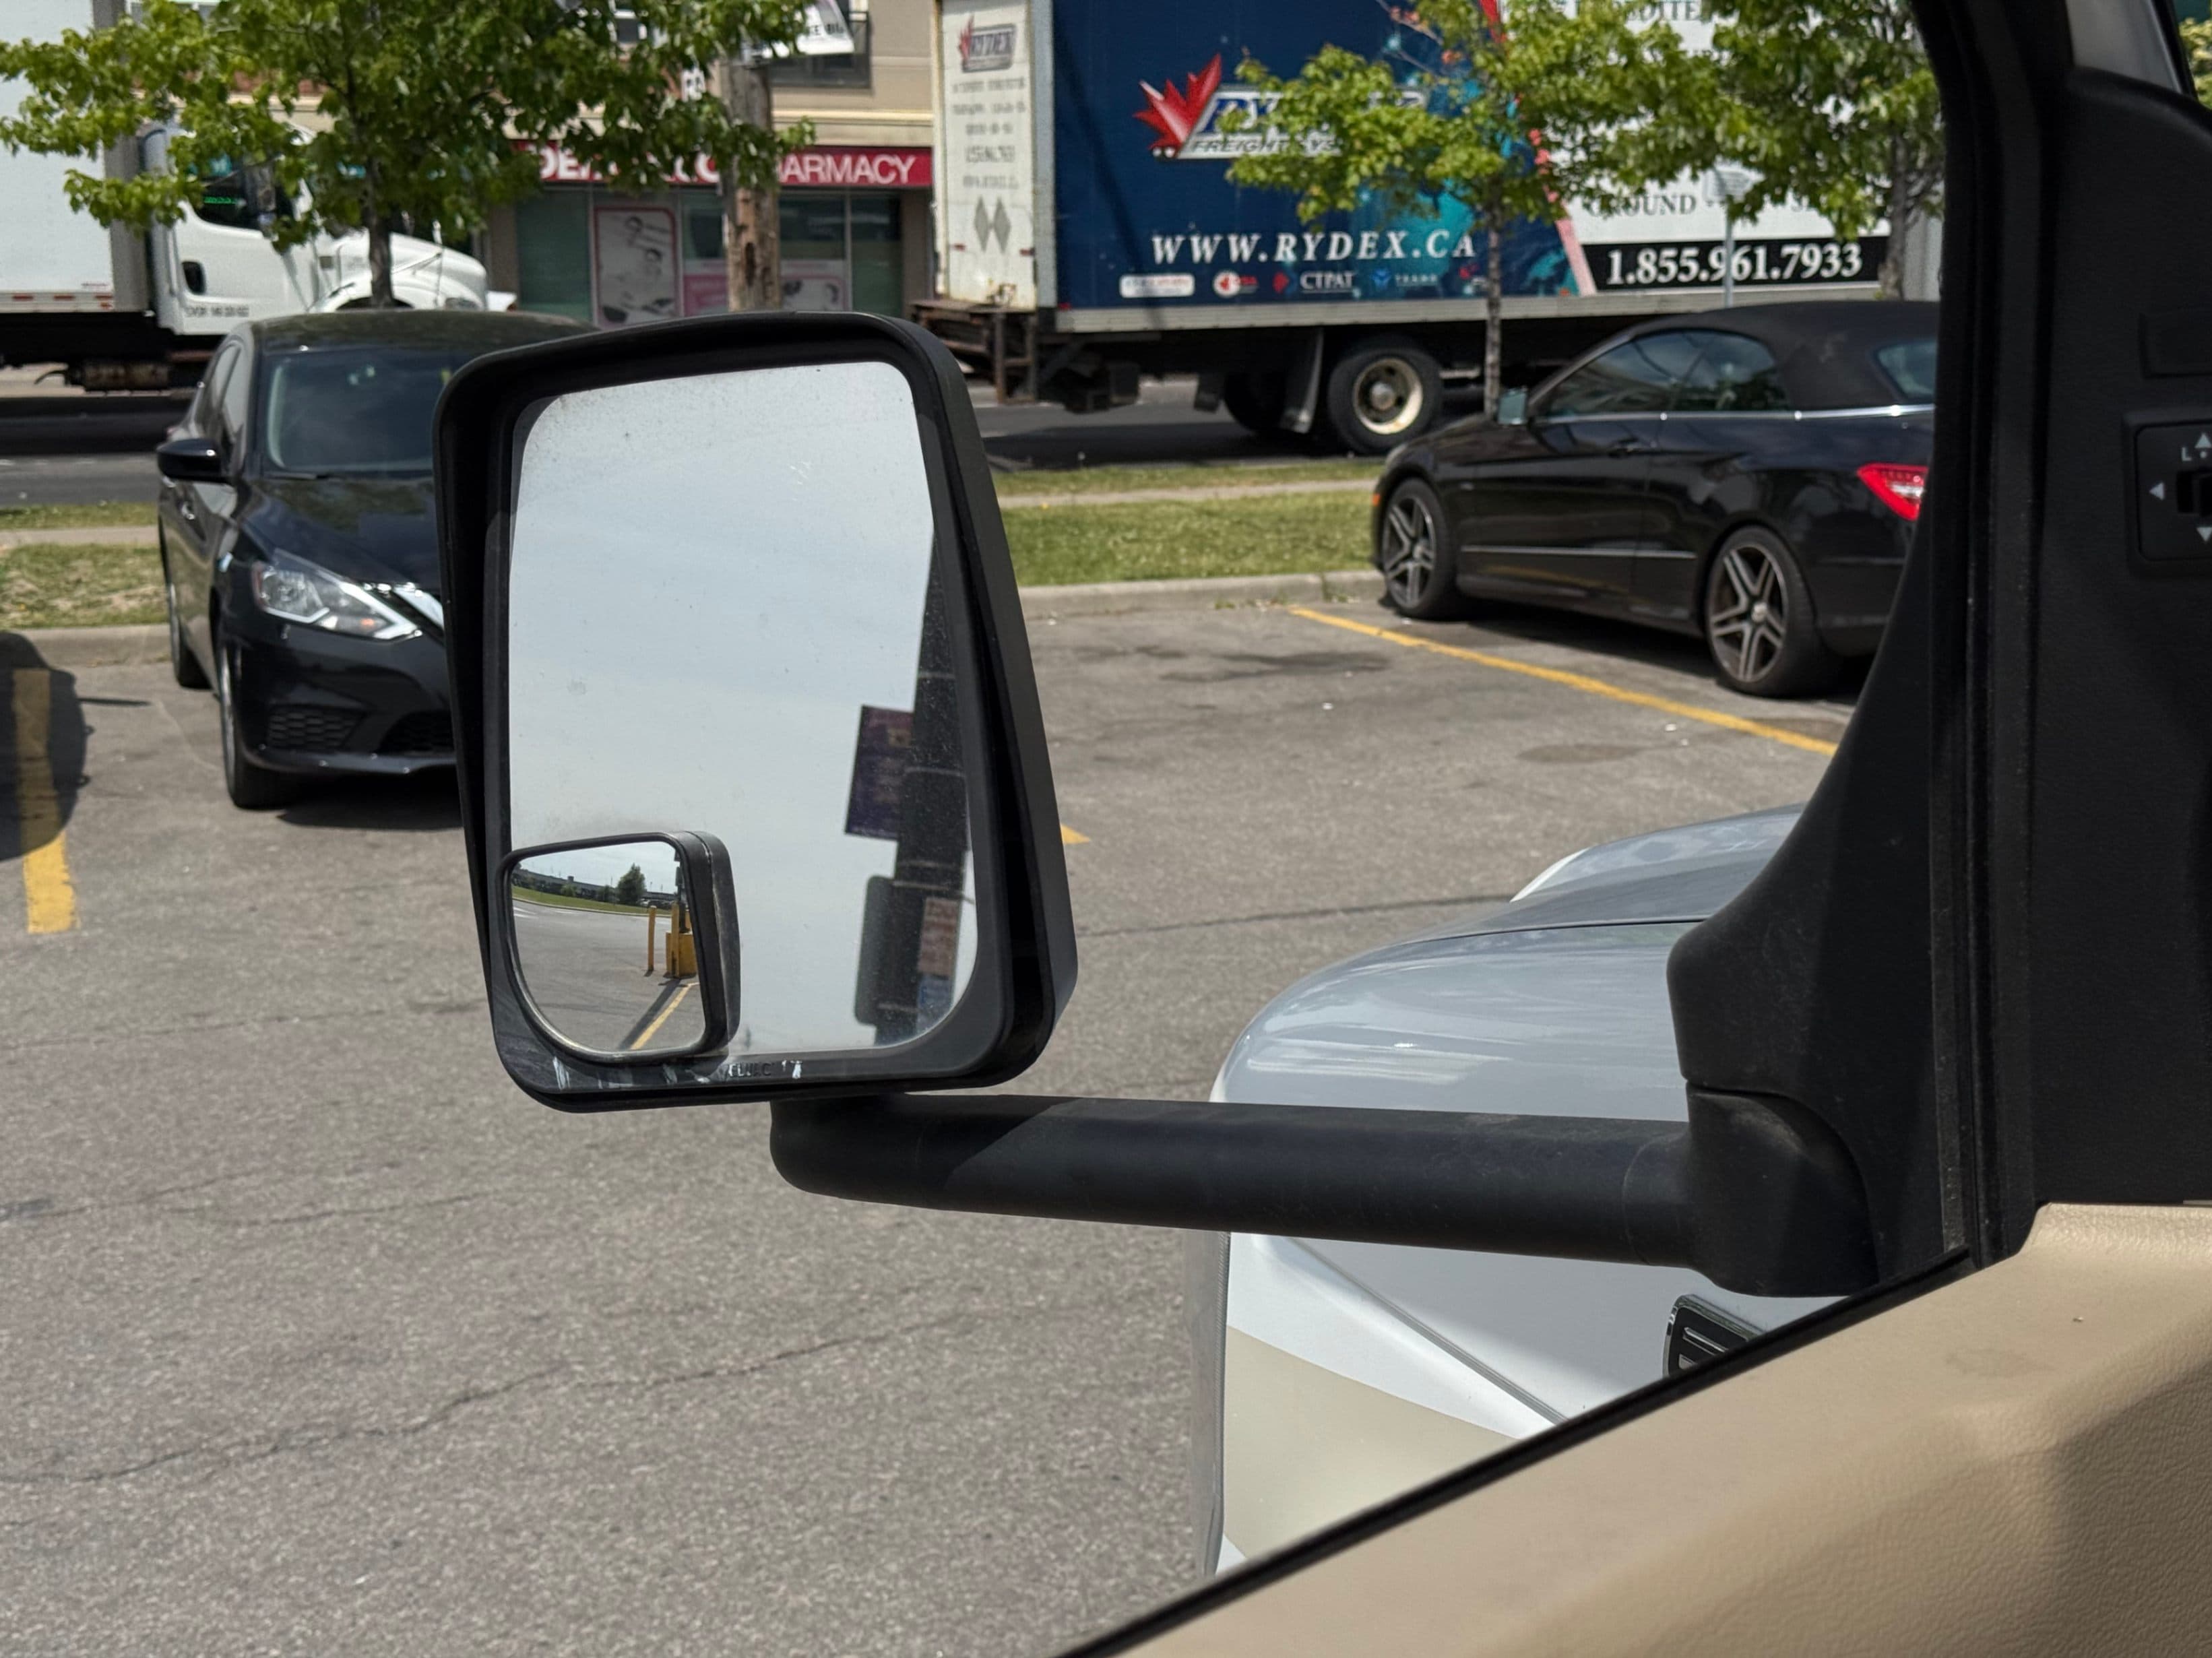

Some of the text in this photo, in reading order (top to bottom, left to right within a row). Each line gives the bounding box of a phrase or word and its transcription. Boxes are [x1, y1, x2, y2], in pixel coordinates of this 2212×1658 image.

[778, 154, 916, 184] ARMACY
[1151, 229, 1476, 264] WWW.RYDEX.CA
[1606, 242, 1863, 285] 1.855.961.7933
[1300, 271, 1354, 290] CTPAT
[2181, 447, 2192, 461] L
